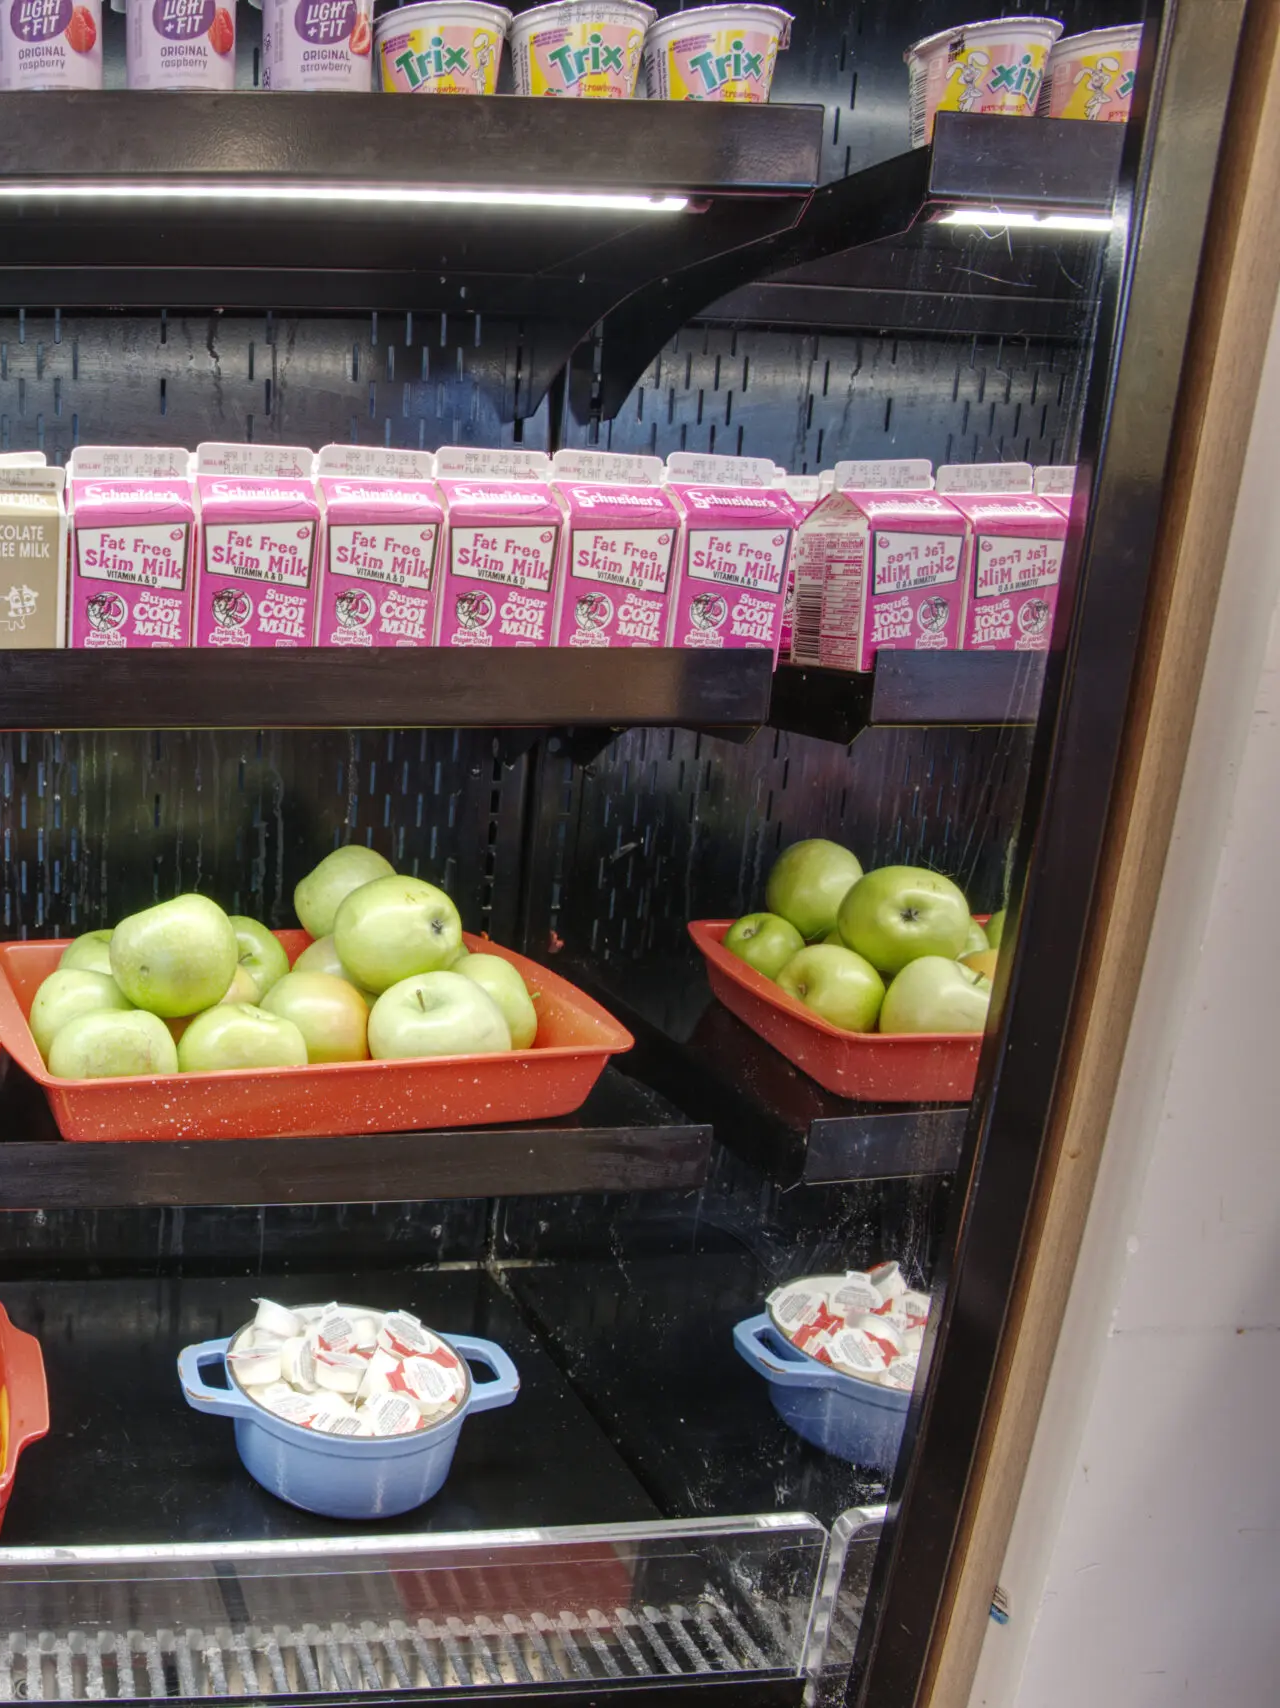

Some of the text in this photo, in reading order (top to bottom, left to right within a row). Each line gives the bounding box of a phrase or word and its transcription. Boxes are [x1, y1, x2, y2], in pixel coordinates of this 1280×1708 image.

[18, 47, 66, 58] ORIGINAL
[160, 46, 208, 57] ORIGINAL
[303, 51, 349, 62] ORIGINAL
[550, 33, 624, 88] Trix
[18, 58, 65, 70] raspberry
[161, 58, 208, 70] raspberry
[300, 62, 352, 74] strawberry
[395, 36, 469, 90] Trix
[690, 40, 763, 93] Trix
[20, 542, 50, 557] MILK
[100, 534, 172, 557] Fat Free
[227, 531, 298, 555] Fat Free
[352, 531, 421, 556] Fat Free
[473, 534, 541, 558] Fat Free
[593, 536, 658, 560] Fat Free
[708, 537, 772, 561] Fat Free
[85, 549, 182, 579] Skim Milk
[212, 546, 308, 577] Skim Milk
[336, 546, 431, 579] Skim Milk
[457, 548, 549, 581] Skim Milk
[578, 551, 667, 583] Skim Milk
[693, 551, 780, 583] Skim Milk
[107, 570, 136, 582] VITAMIN
[234, 566, 262, 578] VITAMIN
[357, 568, 385, 580] VITAMIN
[478, 569, 506, 581] VITAMIN
[597, 571, 624, 583] VITAMIN
[713, 571, 739, 583] VITAMIN
[140, 591, 182, 608] Super
[265, 589, 307, 605] Super
[387, 590, 428, 606] Super
[507, 591, 547, 608] Super
[625, 593, 663, 609] Super
[739, 594, 776, 610] Super
[133, 621, 182, 639] Milk
[258, 619, 305, 638] Milk
[379, 619, 426, 639] Milk
[500, 621, 545, 640] Milk
[616, 621, 661, 641] Milk
[730, 621, 773, 641] Milk
